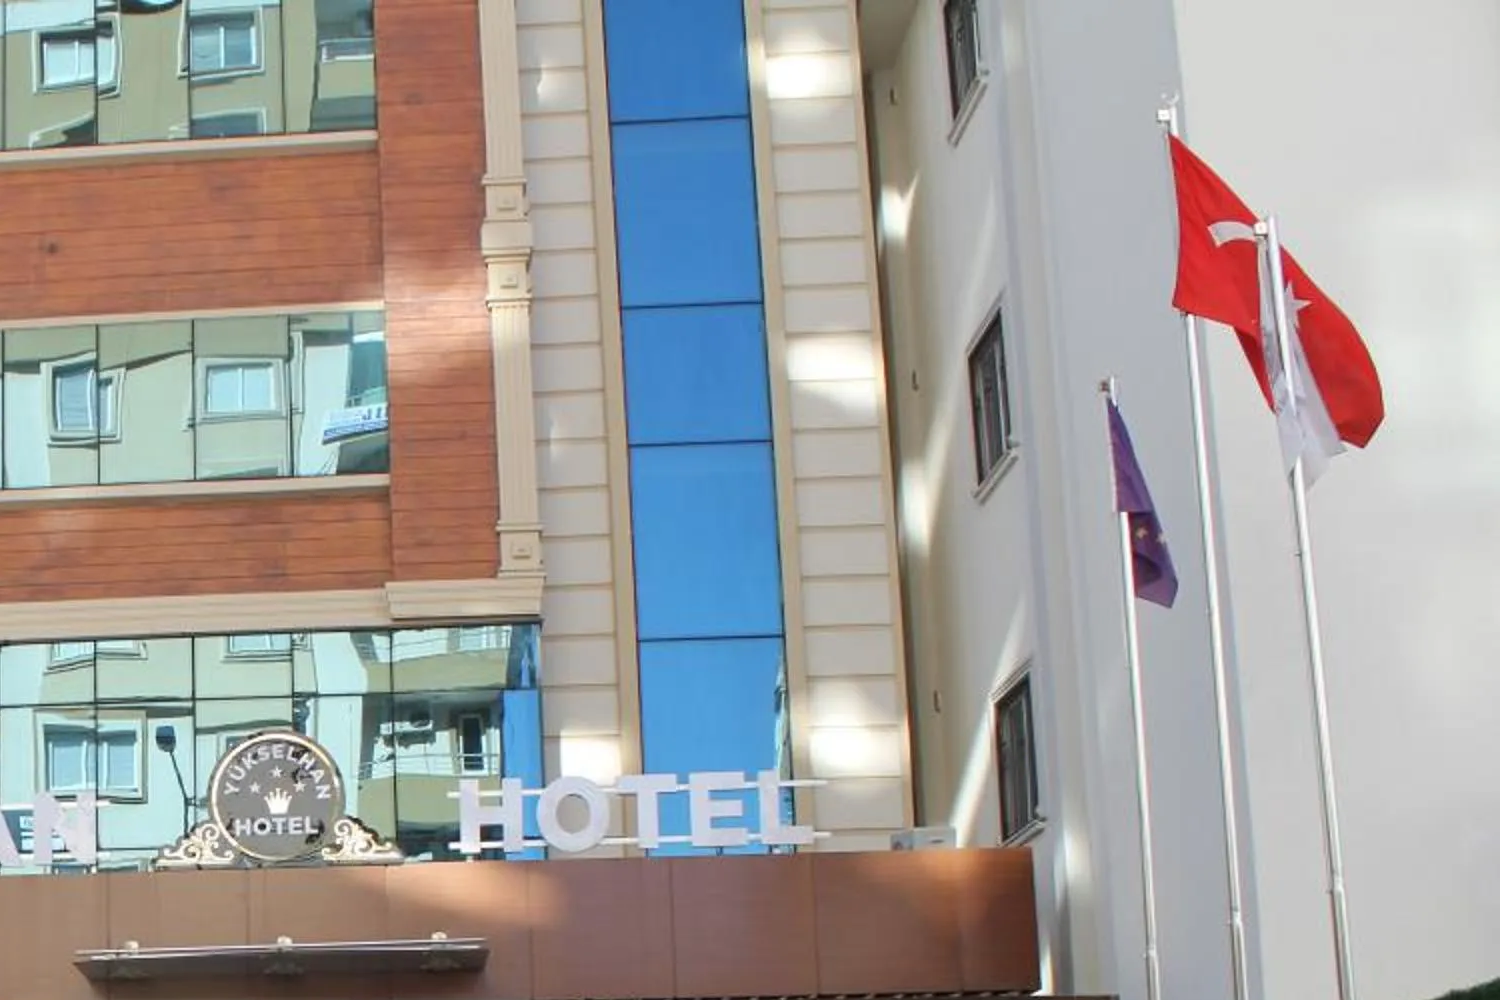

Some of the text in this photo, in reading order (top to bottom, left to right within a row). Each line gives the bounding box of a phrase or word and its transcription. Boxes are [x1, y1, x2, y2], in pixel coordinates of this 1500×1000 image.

[223, 743, 332, 800] YÜKSELHAN
[233, 816, 320, 837] HOTEL
[458, 769, 814, 854] HOTEL
